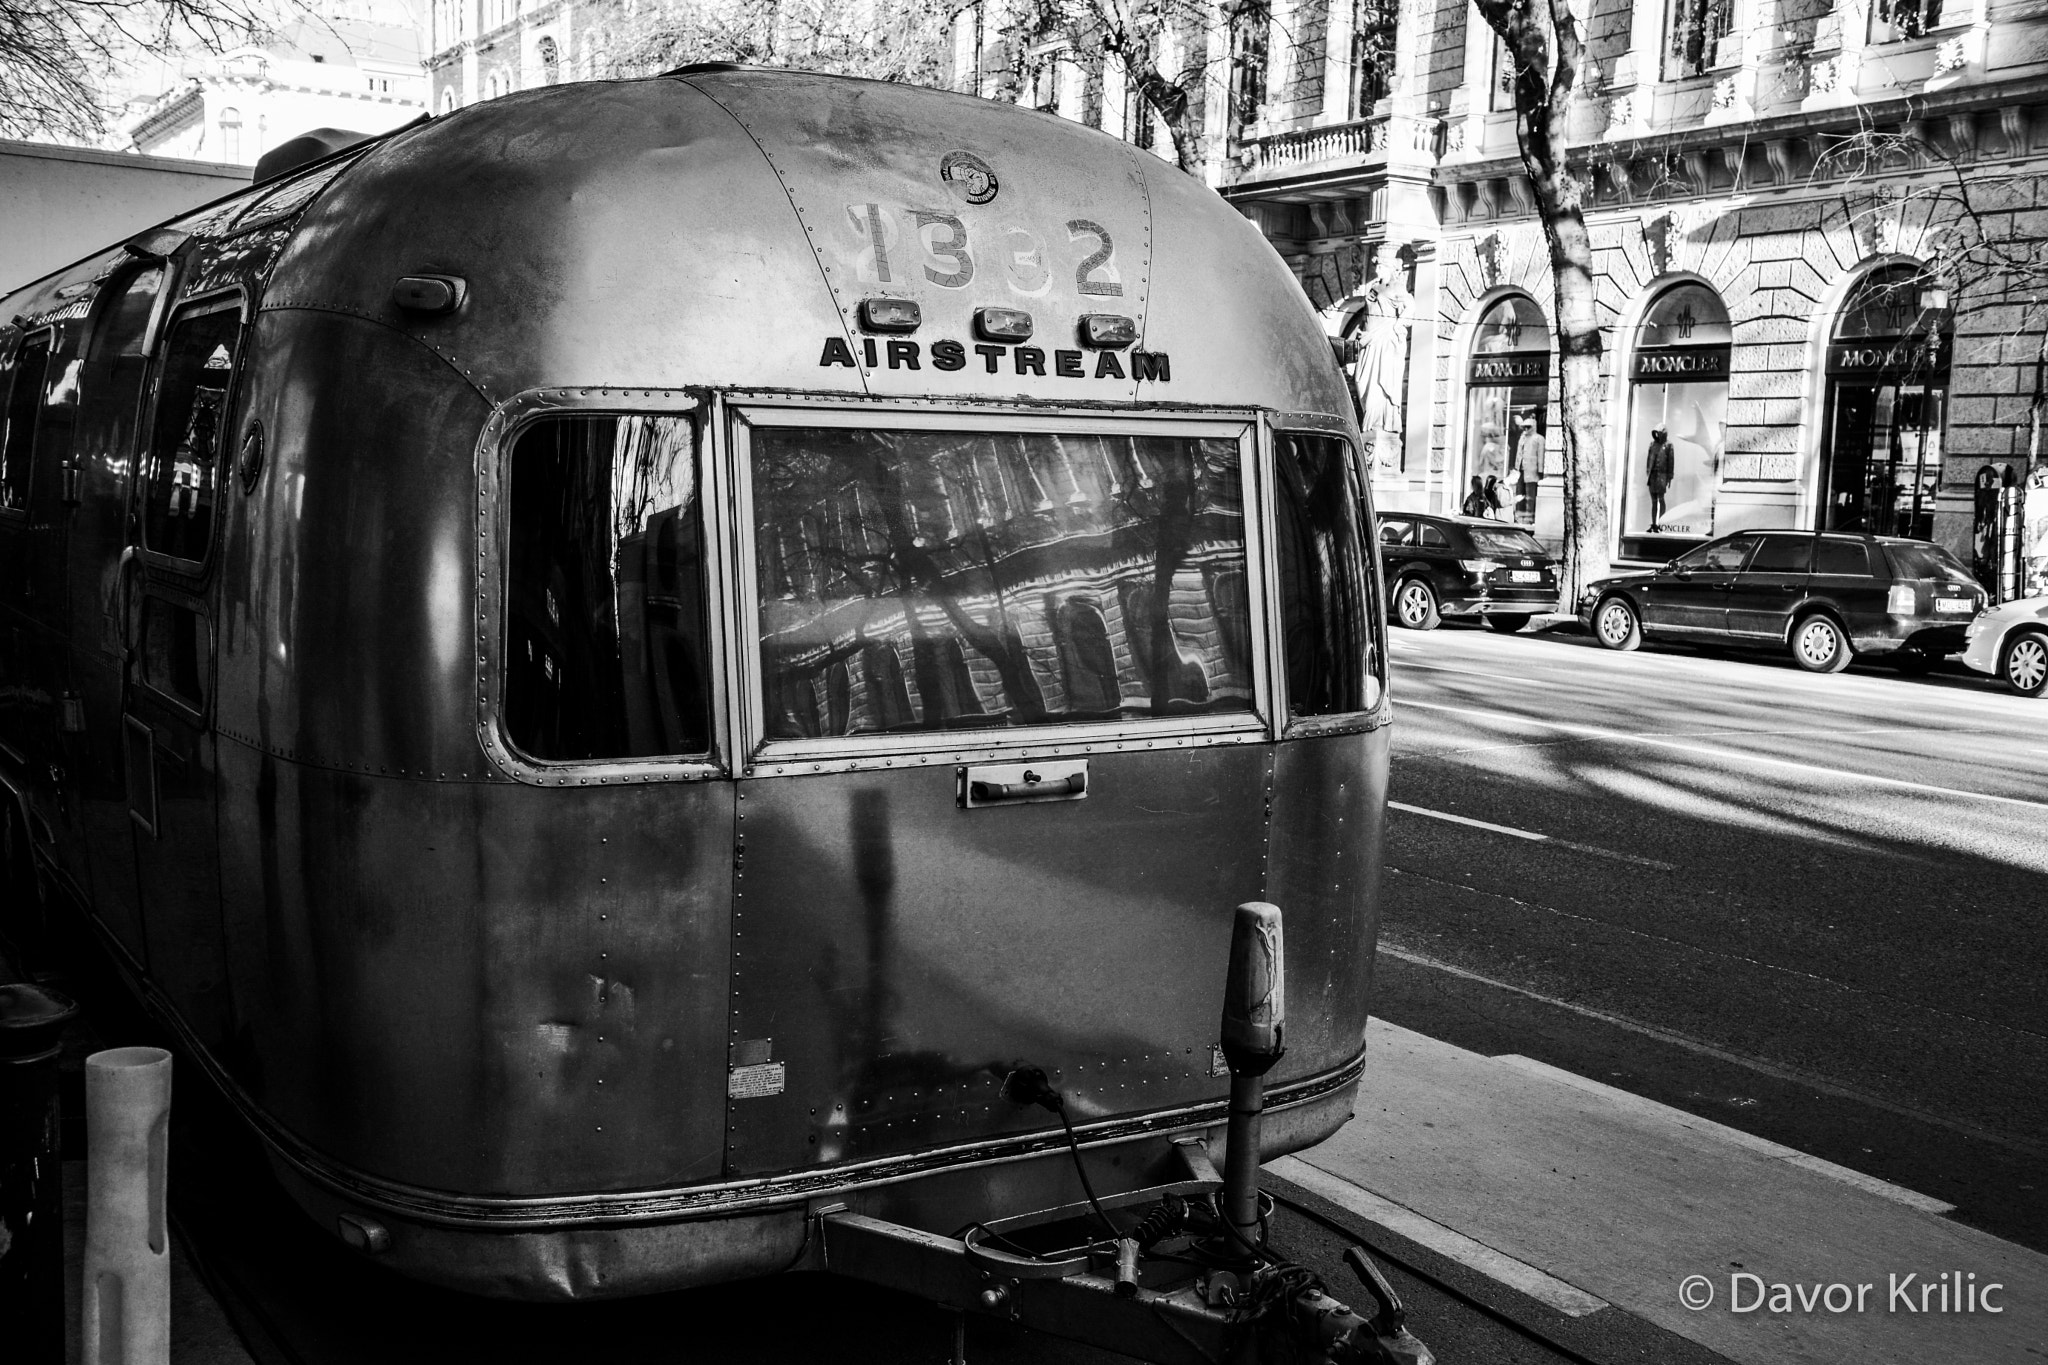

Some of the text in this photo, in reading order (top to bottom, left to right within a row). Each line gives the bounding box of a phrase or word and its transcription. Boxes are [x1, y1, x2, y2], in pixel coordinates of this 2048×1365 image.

[819, 337, 1171, 382] AIRSTREAM
[1640, 355, 1720, 373] MONCLER
[1475, 362, 1542, 378] MONCLER
